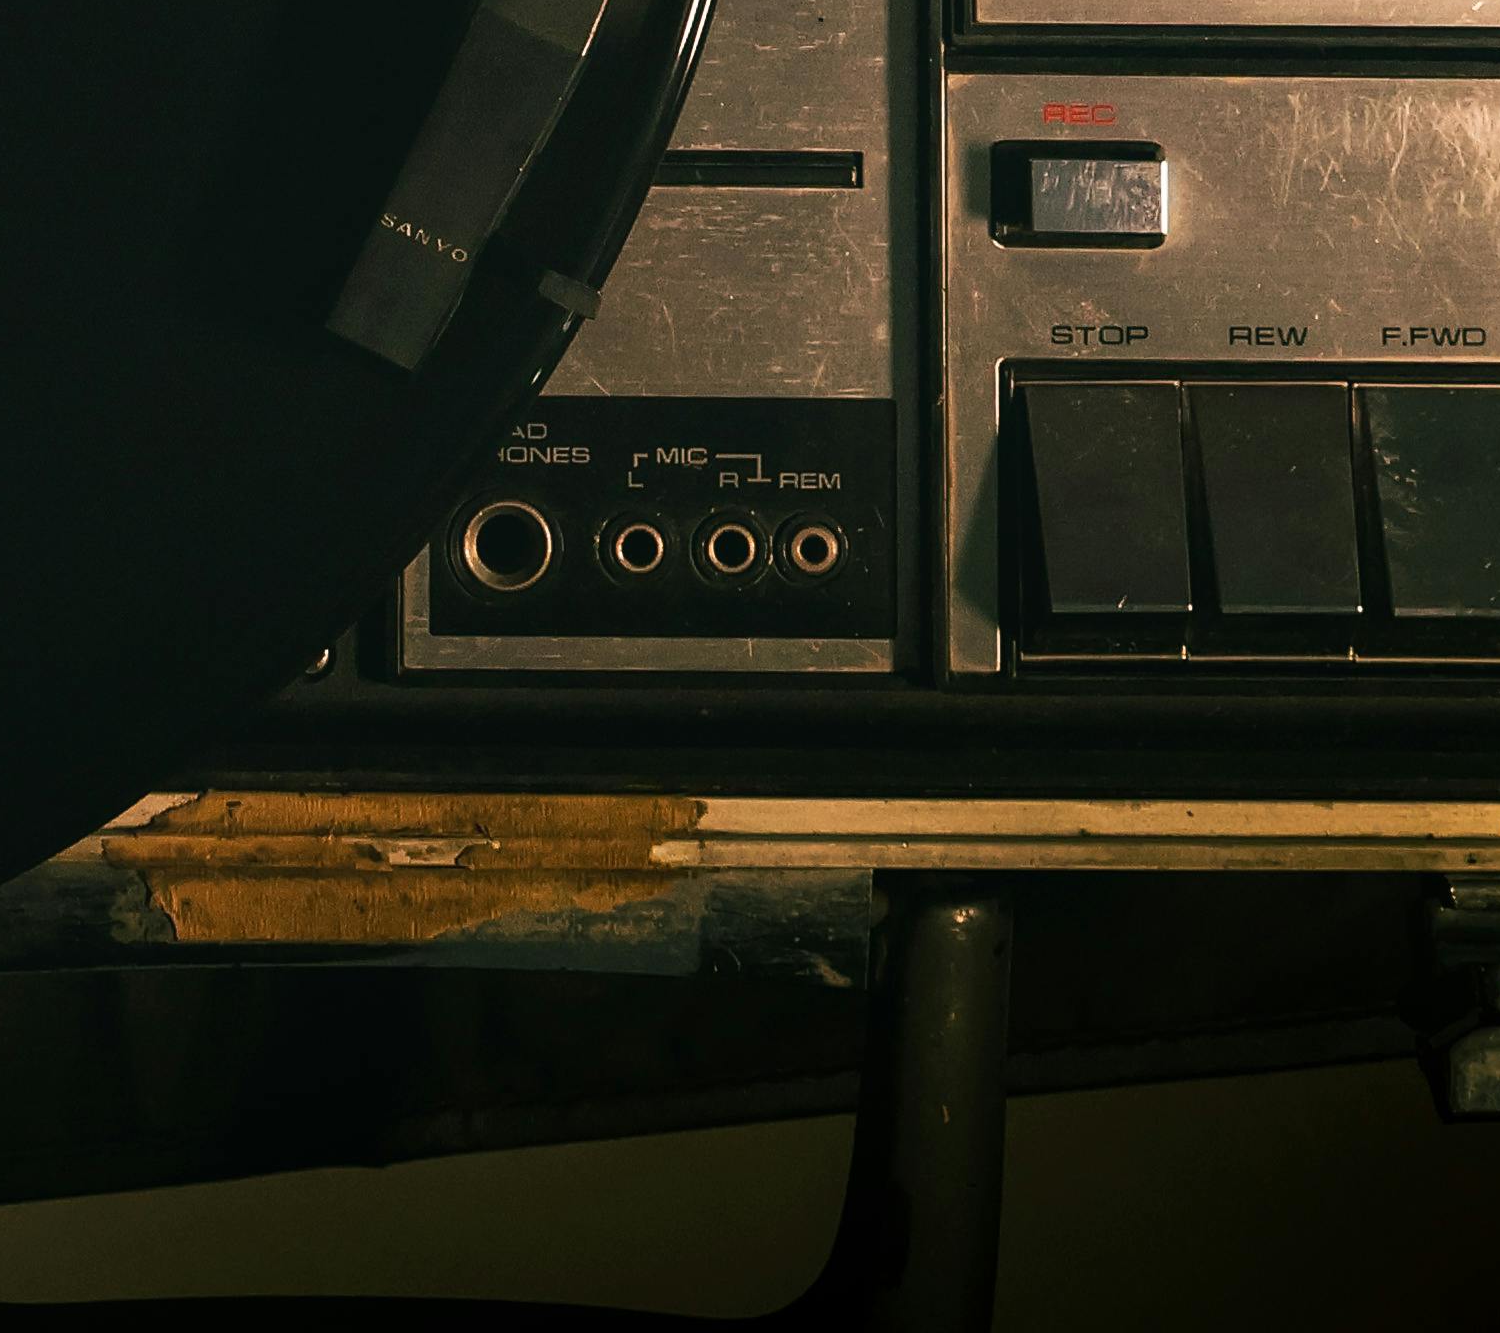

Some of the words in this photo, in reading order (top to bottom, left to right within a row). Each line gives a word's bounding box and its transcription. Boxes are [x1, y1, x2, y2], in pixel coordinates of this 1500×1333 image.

[1042, 103, 1118, 126] REC
[380, 212, 468, 262] SANYO
[1051, 324, 1150, 346] STOP
[1228, 325, 1309, 347] REW
[1382, 326, 1487, 347] F.FWD
[656, 446, 708, 466] MIC
[627, 472, 644, 488] L
[719, 472, 740, 489] R
[779, 473, 842, 490] REM
